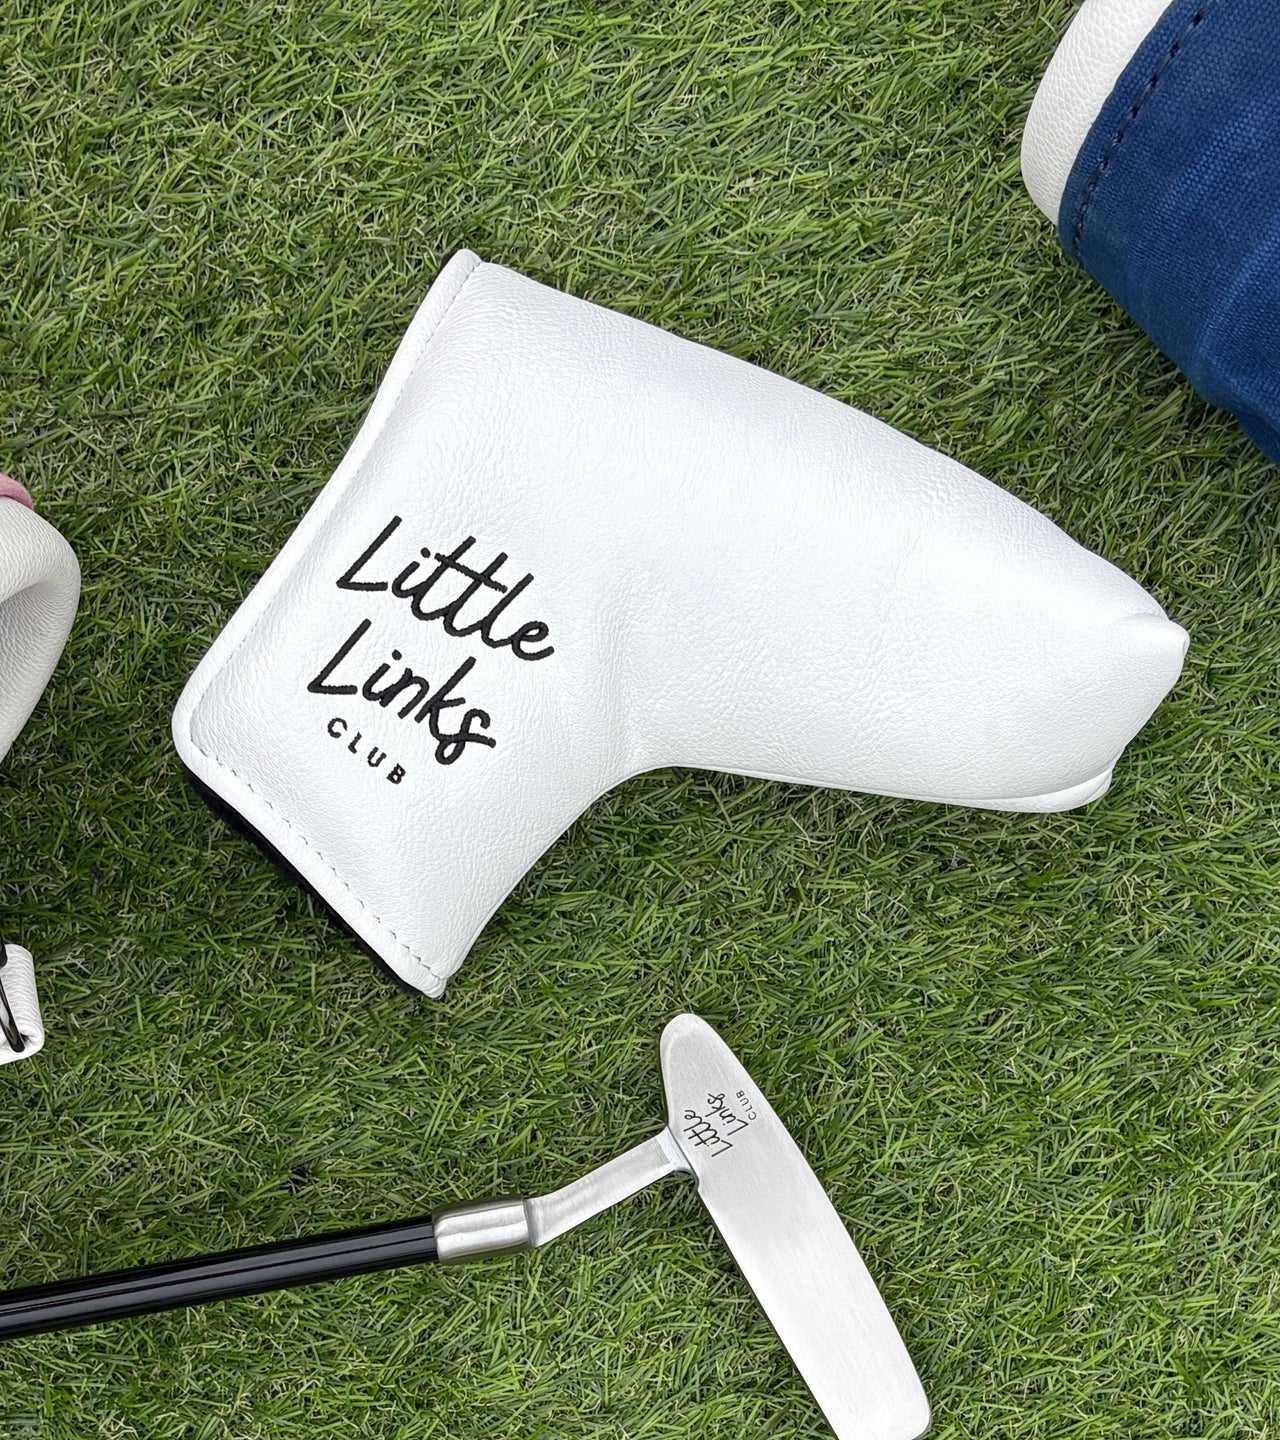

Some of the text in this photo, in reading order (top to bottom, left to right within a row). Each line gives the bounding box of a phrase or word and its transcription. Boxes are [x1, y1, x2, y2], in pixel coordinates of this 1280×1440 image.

[335, 515, 555, 661] Little
[307, 618, 497, 766] Links
[326, 717, 407, 785] CLUB
[683, 1109, 734, 1158] Little
[705, 1092, 749, 1136] Links
[735, 1090, 757, 1121] CLUB
